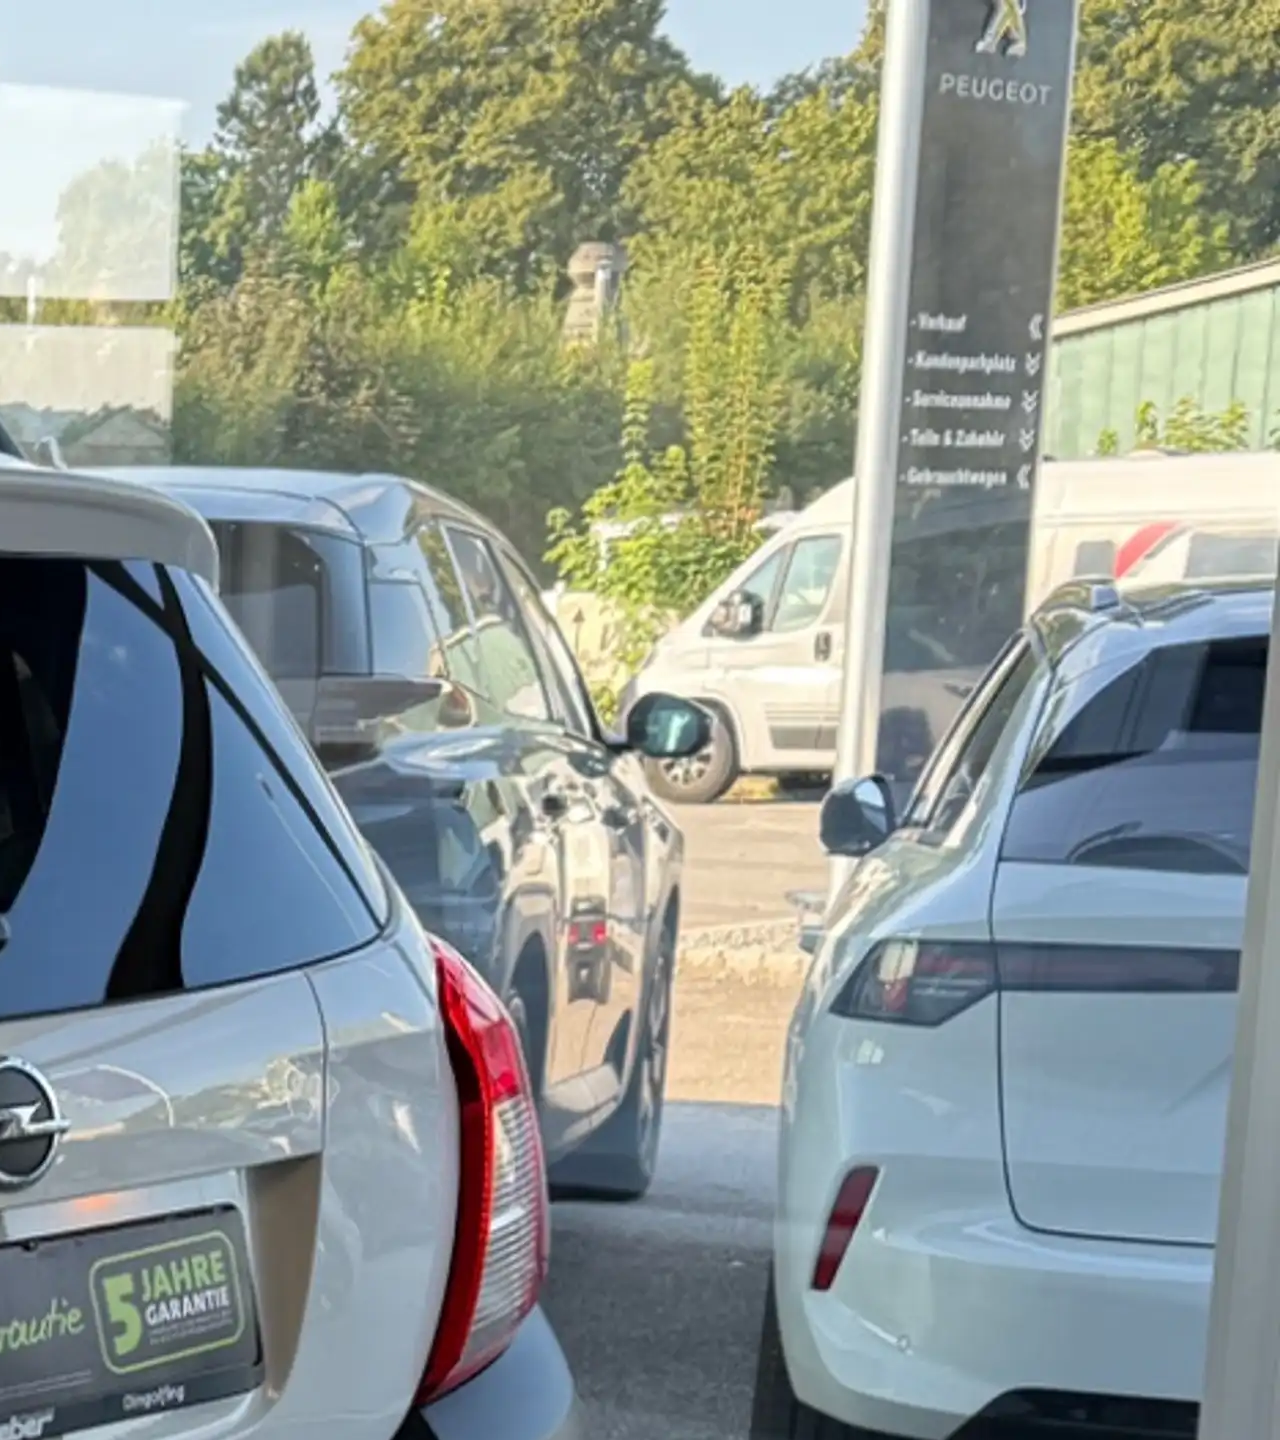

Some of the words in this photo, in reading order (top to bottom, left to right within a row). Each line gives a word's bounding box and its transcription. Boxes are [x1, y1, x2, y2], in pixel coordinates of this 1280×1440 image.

[939, 72, 1052, 105] PEUGEOT
[141, 1250, 227, 1302] JAHRE
[102, 1273, 142, 1356] 5
[145, 1286, 230, 1326] GARANTIE
